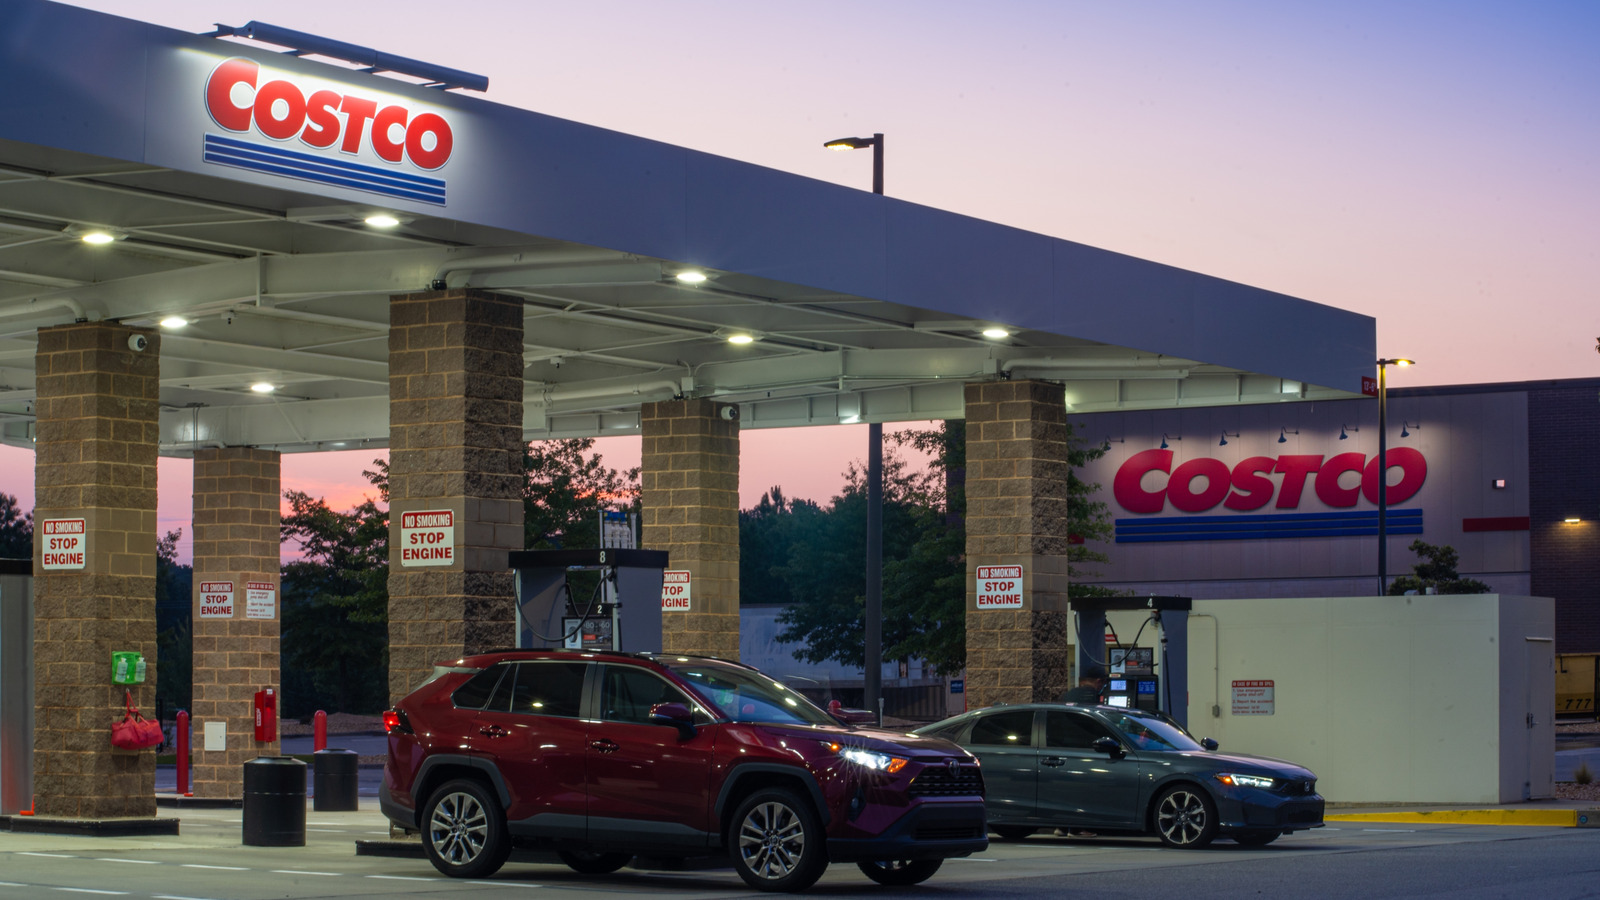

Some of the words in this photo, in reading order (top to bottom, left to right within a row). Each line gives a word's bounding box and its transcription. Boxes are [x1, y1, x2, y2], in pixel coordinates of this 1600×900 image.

[204, 57, 453, 171] COSTCO
[1113, 447, 1427, 514] COSTCO
[404, 514, 415, 528] NO
[416, 513, 450, 527] SMOKING
[45, 522, 54, 533] NO
[55, 521, 82, 533] SMOKING
[50, 537, 78, 550] STOP
[410, 532, 445, 545] STOP
[44, 553, 84, 565] ENGINE
[403, 547, 453, 560] ENGINE
[600, 551, 606, 563] 8
[980, 568, 989, 578] NO
[990, 567, 1020, 578] SMOKING
[202, 583, 209, 592] NO
[209, 584, 231, 592] SMOKING
[661, 586, 684, 595] TOP
[985, 581, 1015, 592] STOP
[205, 595, 228, 604] STOP
[979, 594, 1021, 605] ENGINE
[1147, 598, 1153, 608] 4
[201, 606, 232, 615] ENGINE
[597, 604, 602, 614] 2
